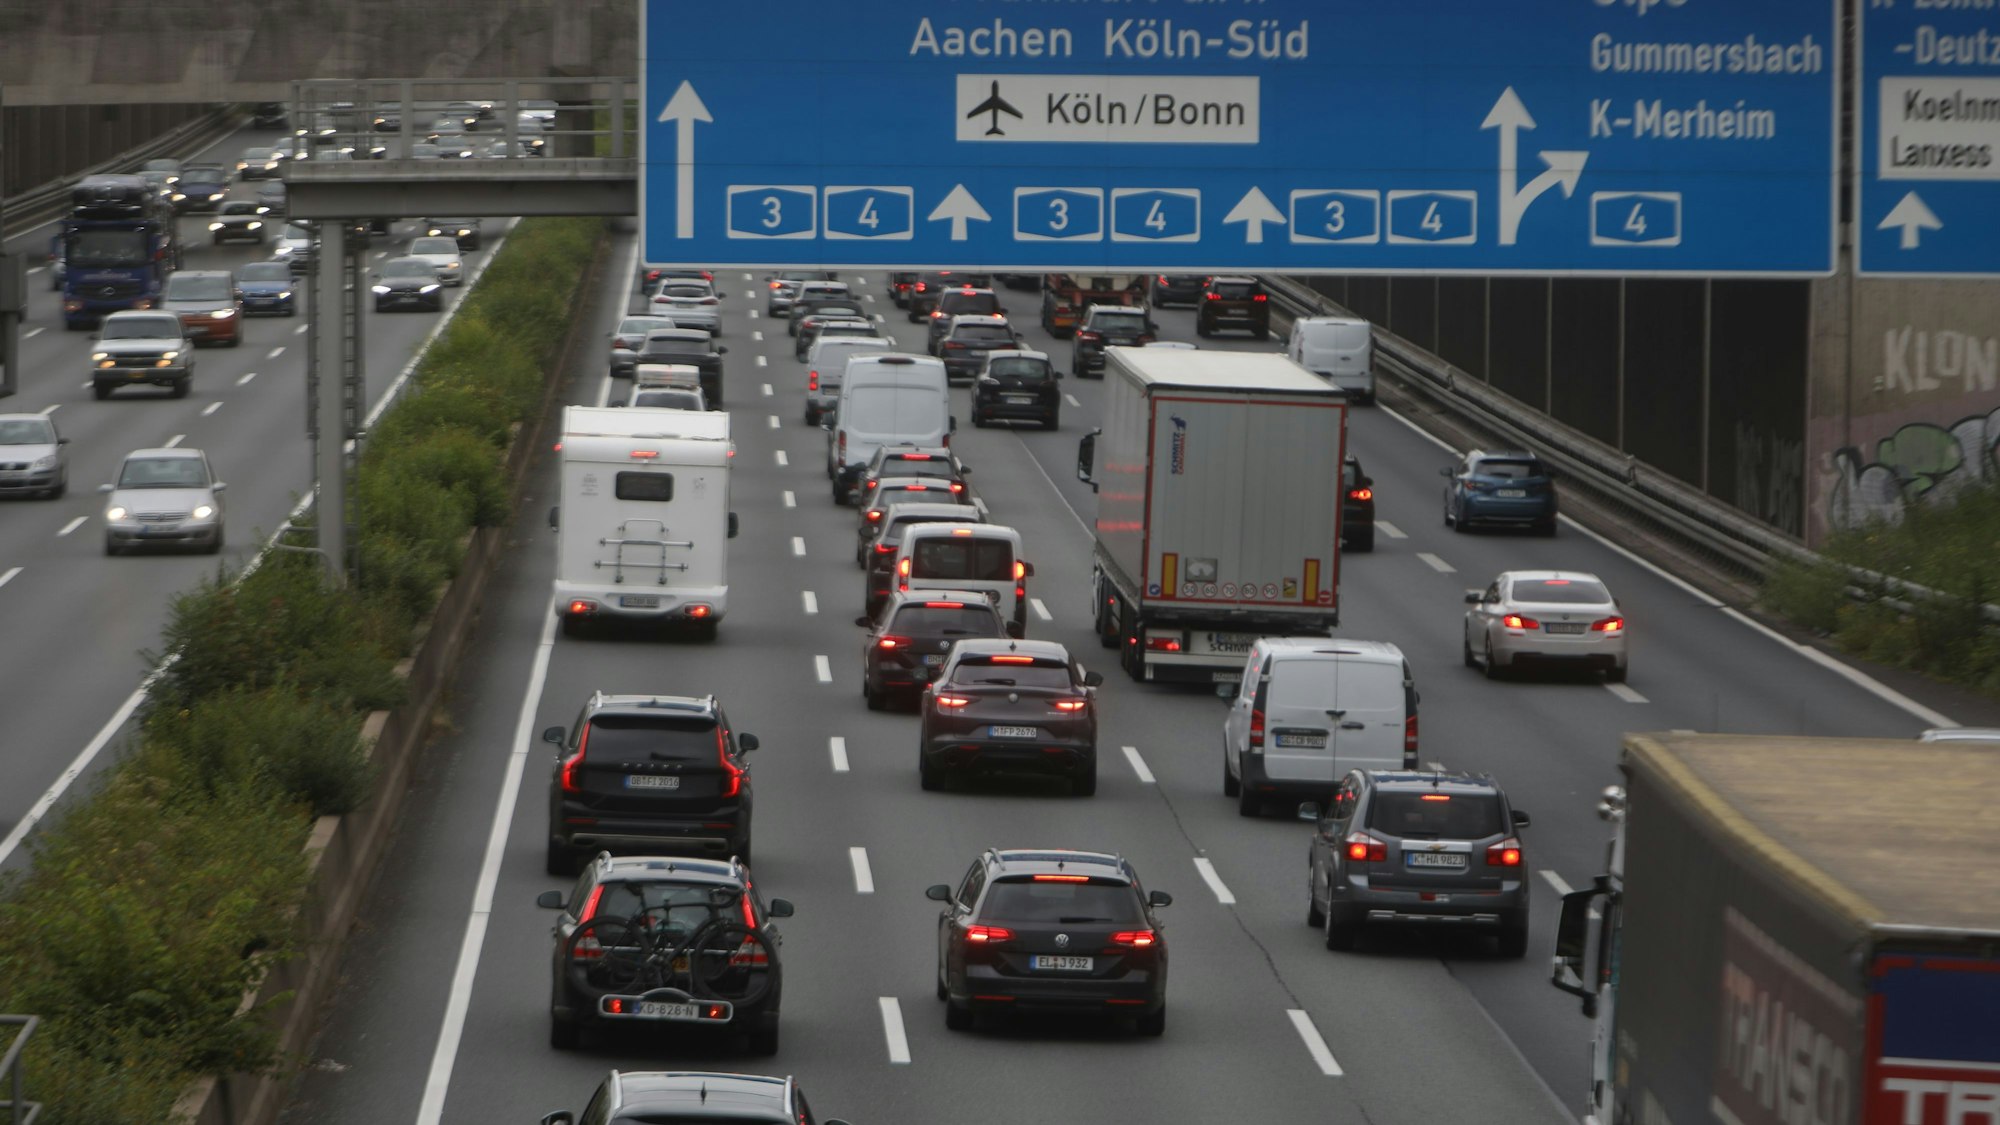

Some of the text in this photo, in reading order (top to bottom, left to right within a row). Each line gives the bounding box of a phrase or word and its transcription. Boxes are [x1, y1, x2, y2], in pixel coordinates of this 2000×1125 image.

[909, 17, 1308, 59] Aachen Köln-Süd
[1590, 32, 1822, 73] Gummersbach
[1046, 92, 1245, 126] Köln/Bonn
[1590, 99, 1775, 139] K-Merheim
[1890, 134, 1993, 168] Lanxess
[762, 196, 782, 229] 3
[858, 197, 880, 230] 4
[1048, 199, 1069, 231] 3
[1144, 199, 1168, 231] 4
[1325, 200, 1346, 233] 3
[1420, 201, 1443, 233] 4
[1623, 202, 1648, 235] 4
[1039, 956, 1052, 968] EL
[1068, 958, 1088, 969] 932
